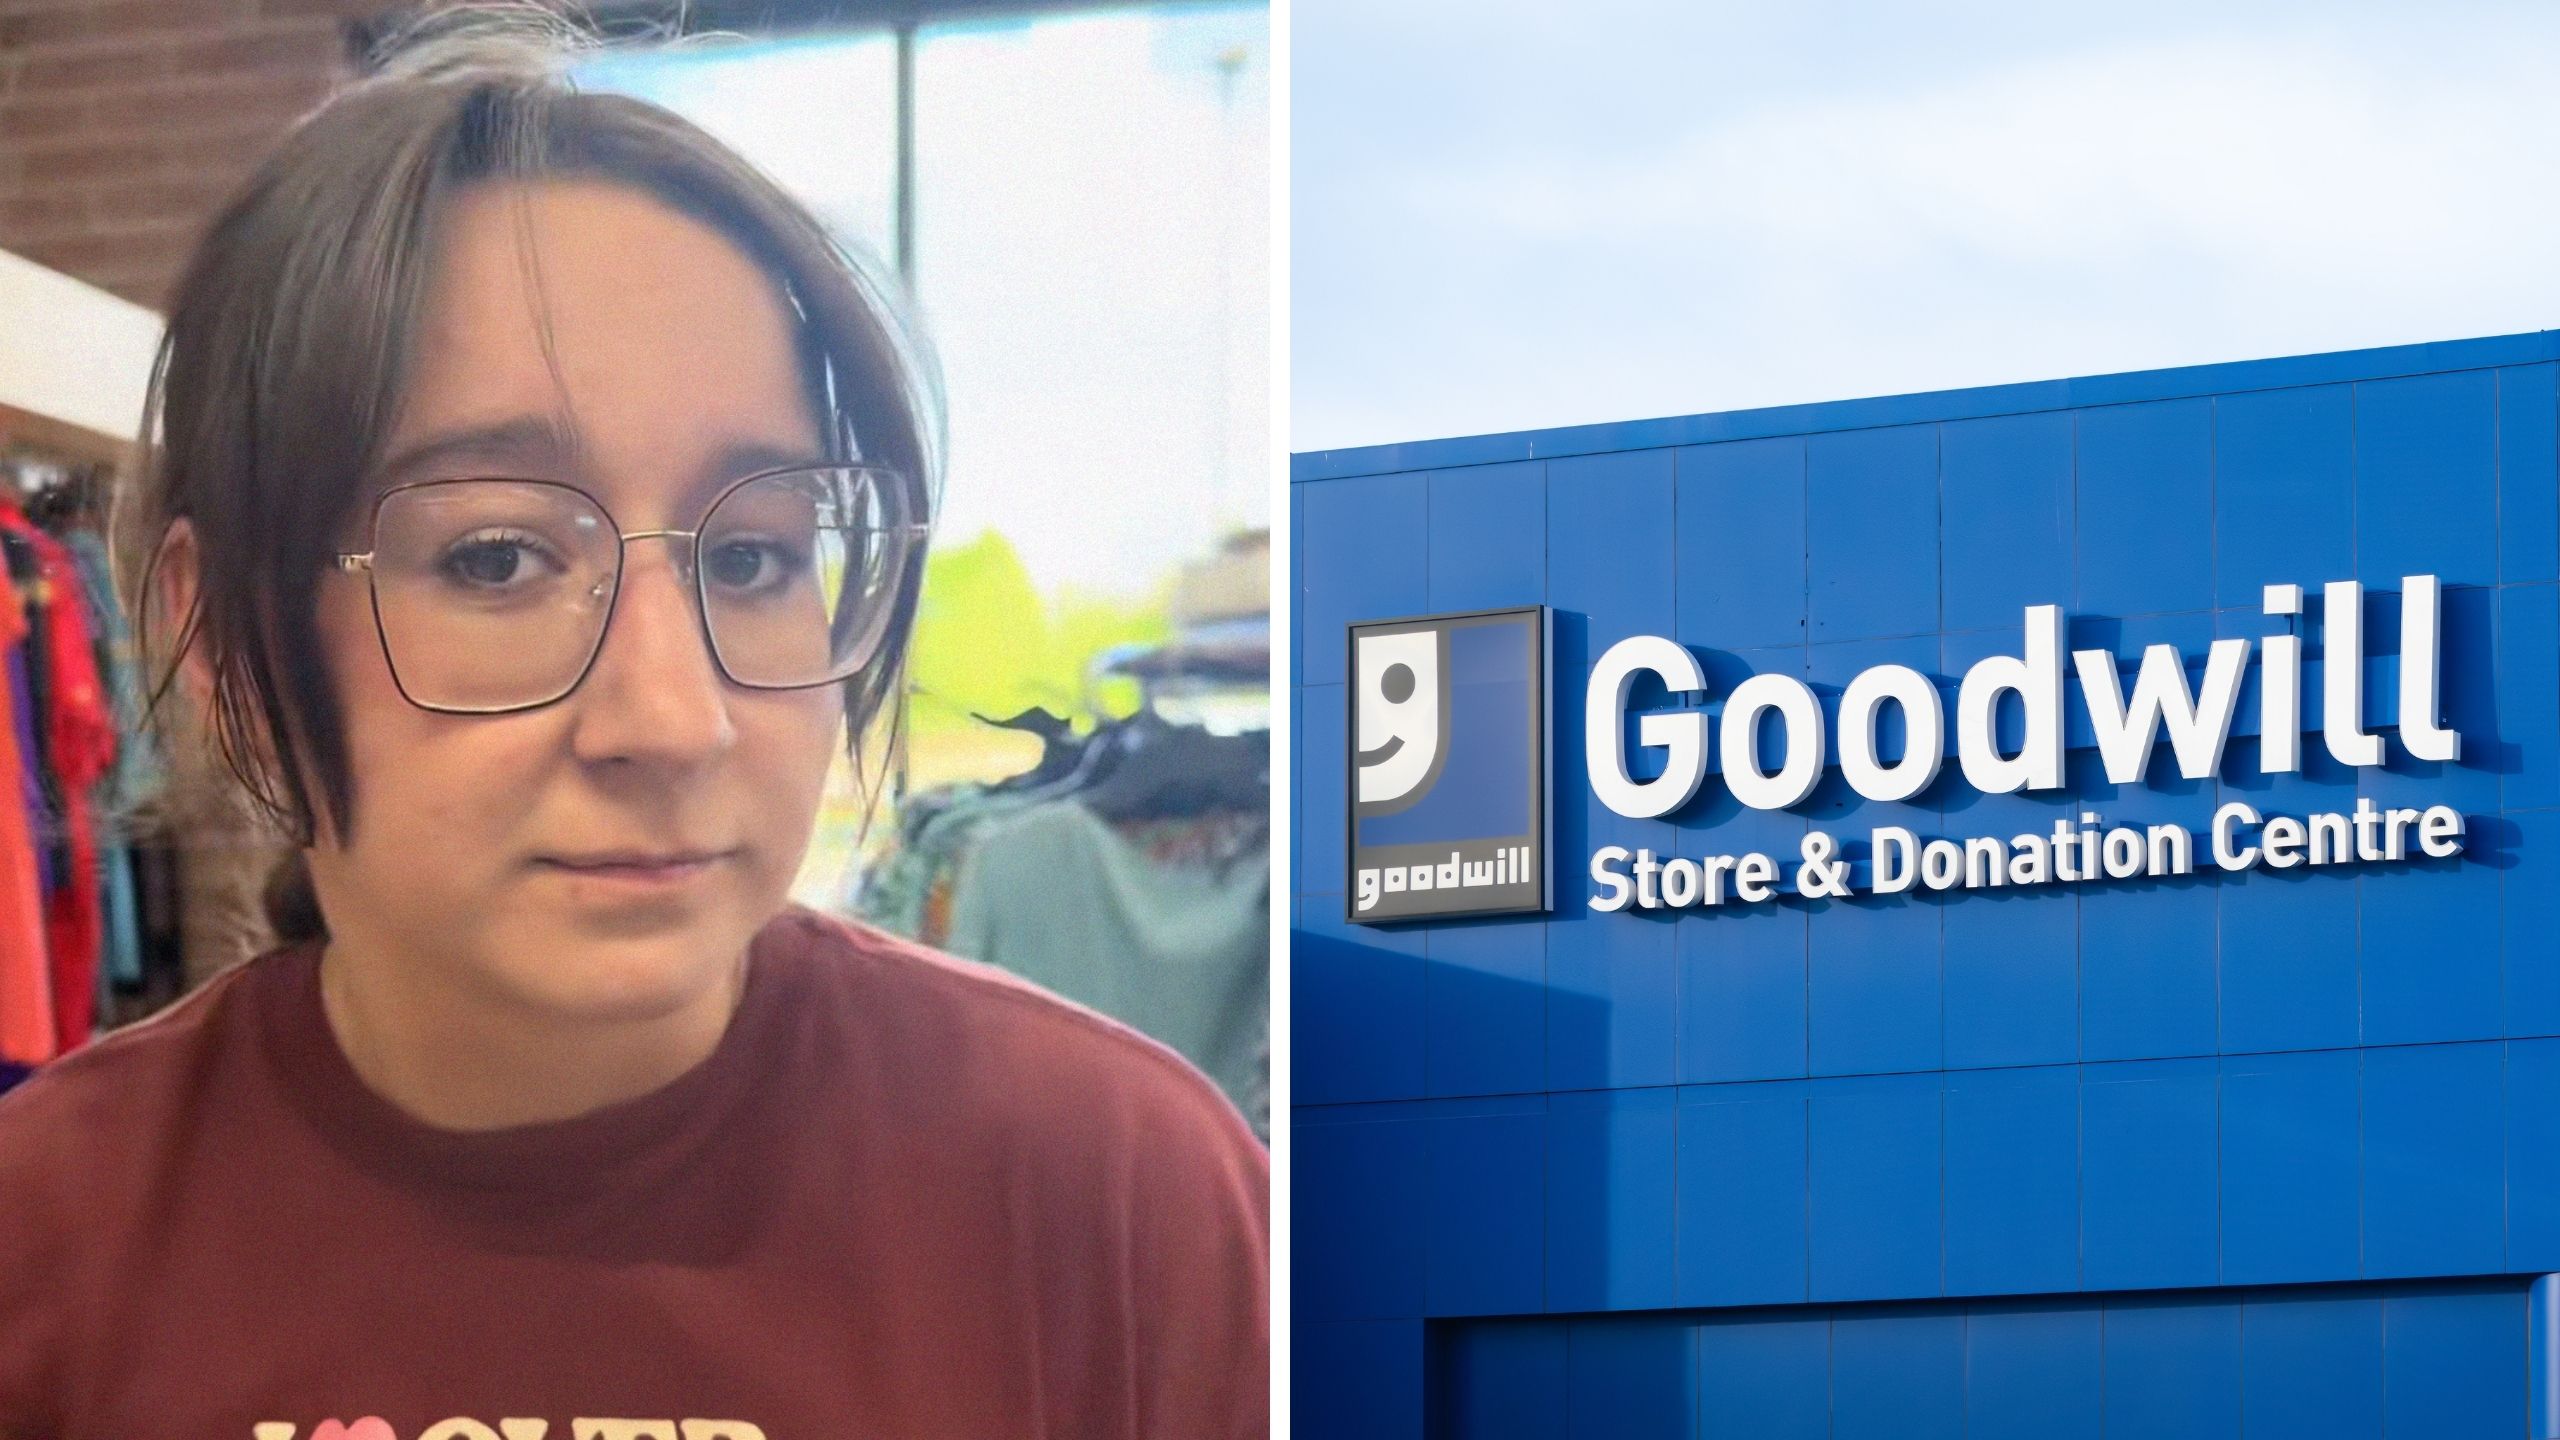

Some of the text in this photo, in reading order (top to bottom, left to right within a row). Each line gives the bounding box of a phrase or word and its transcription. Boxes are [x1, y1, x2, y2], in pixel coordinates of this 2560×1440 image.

[1585, 573, 2462, 820] Goodwill
[1357, 846, 1530, 911] goodwill
[1587, 797, 2466, 912] Store & Donation Centre
